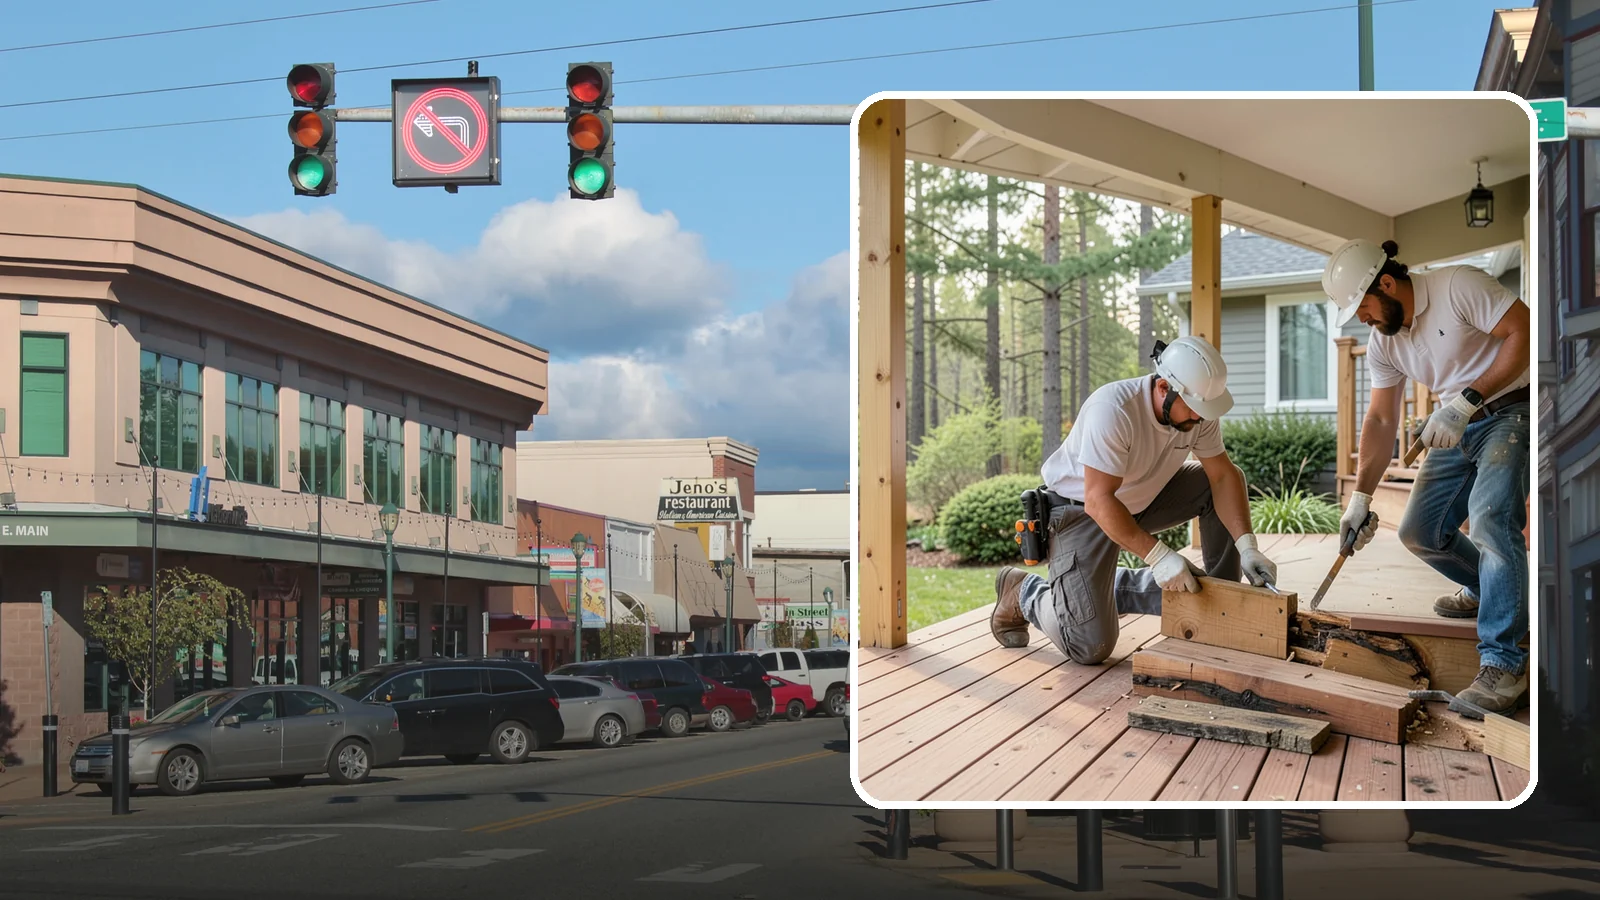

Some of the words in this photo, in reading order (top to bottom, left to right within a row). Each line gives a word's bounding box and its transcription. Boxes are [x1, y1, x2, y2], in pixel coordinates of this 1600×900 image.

[669, 480, 728, 495] Jeno's
[665, 496, 731, 509] restaurant
[658, 510, 682, 520] Italian
[686, 509, 715, 520] American
[715, 510, 738, 520] Cuisine
[2, 525, 13, 536] E.
[15, 525, 49, 536] MAIN
[797, 607, 829, 617] Street
